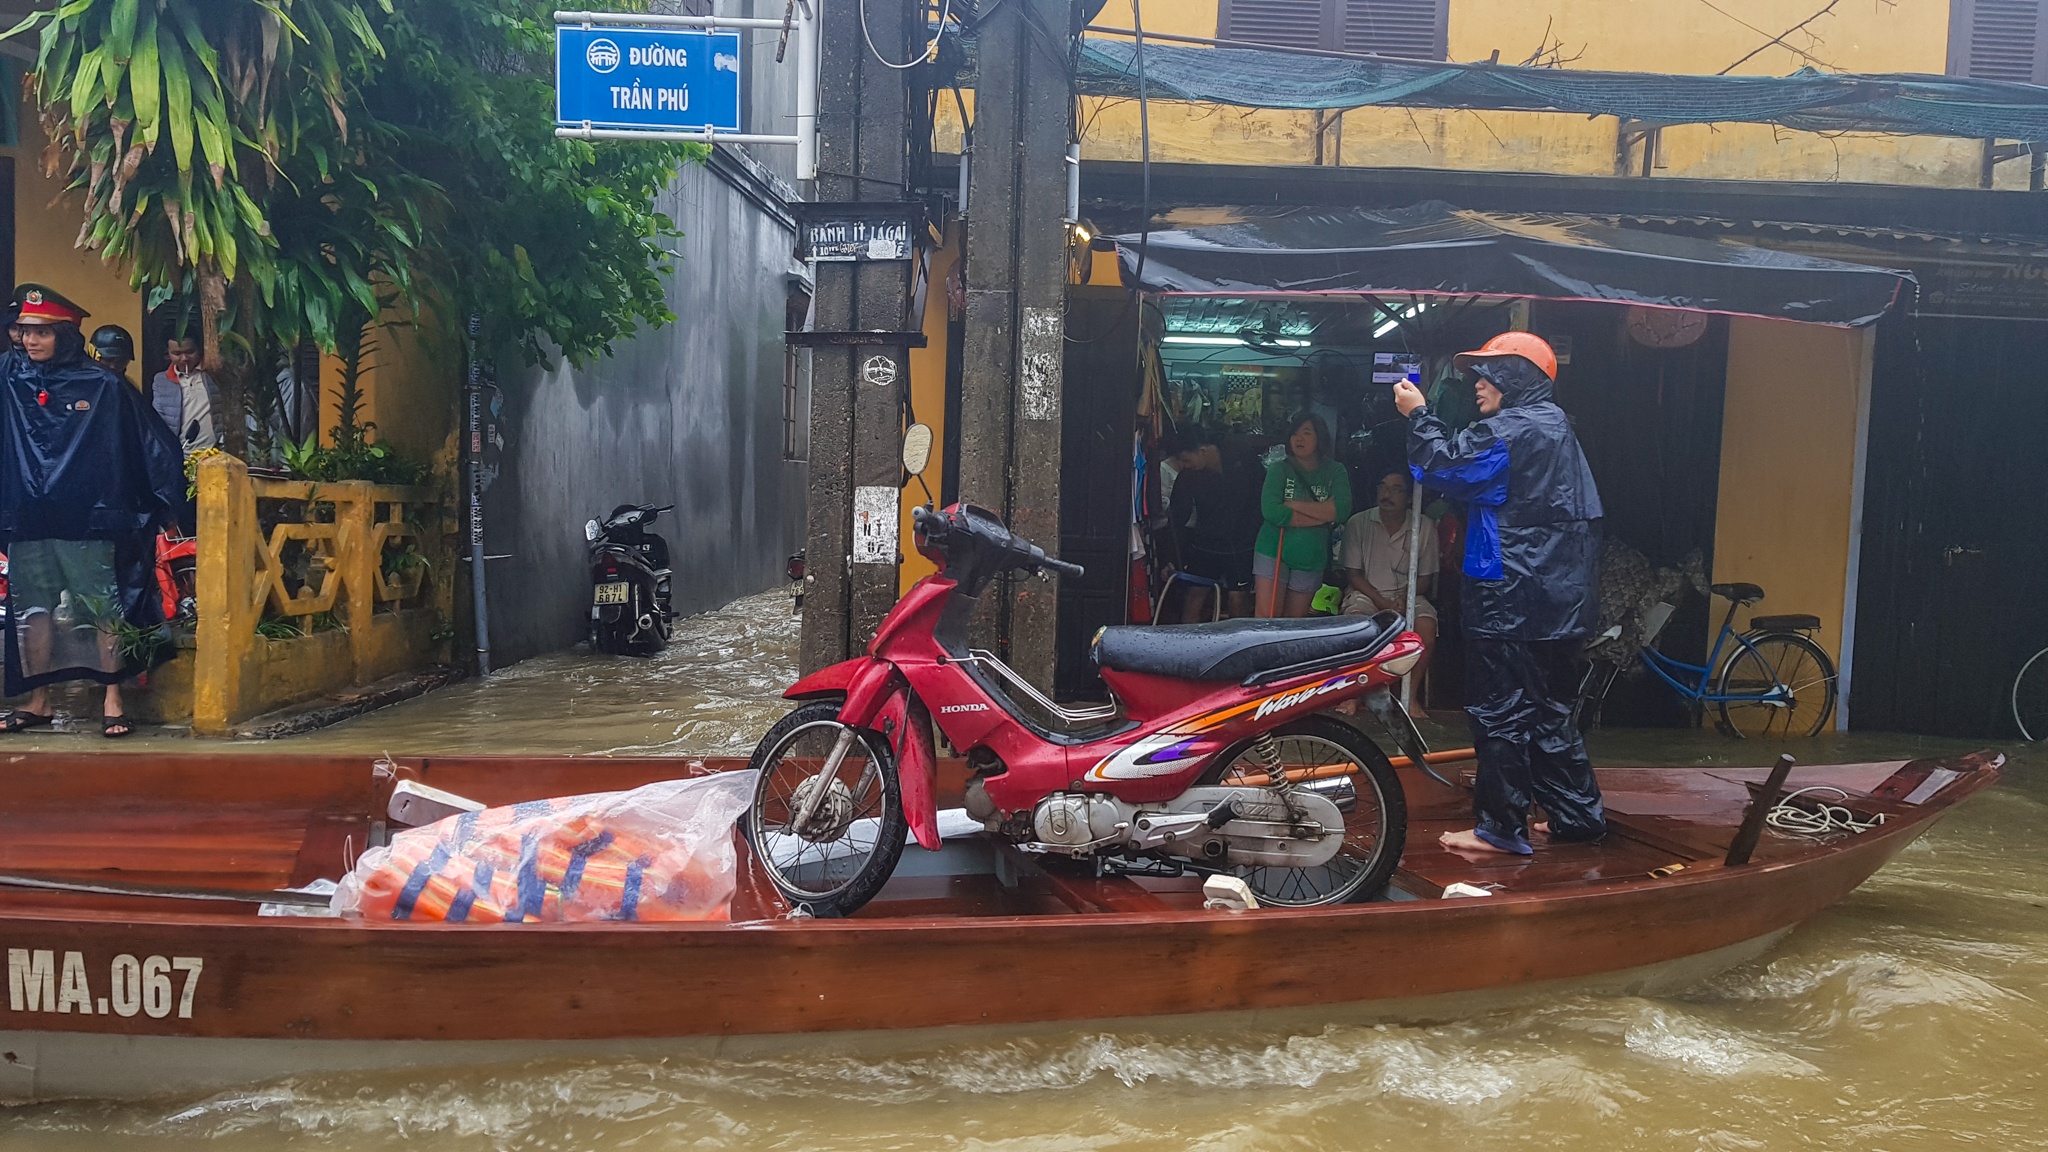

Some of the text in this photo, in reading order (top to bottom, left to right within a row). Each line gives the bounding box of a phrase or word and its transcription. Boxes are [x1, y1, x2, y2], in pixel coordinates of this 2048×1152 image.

[629, 42, 687, 67] ĐƯỜNG
[610, 77, 689, 111] TRẦN PHÚ
[810, 222, 846, 243] BÁNH
[599, 584, 622, 594] 92-H1
[941, 703, 990, 714] HONDA
[8, 948, 203, 1019] MA.067
